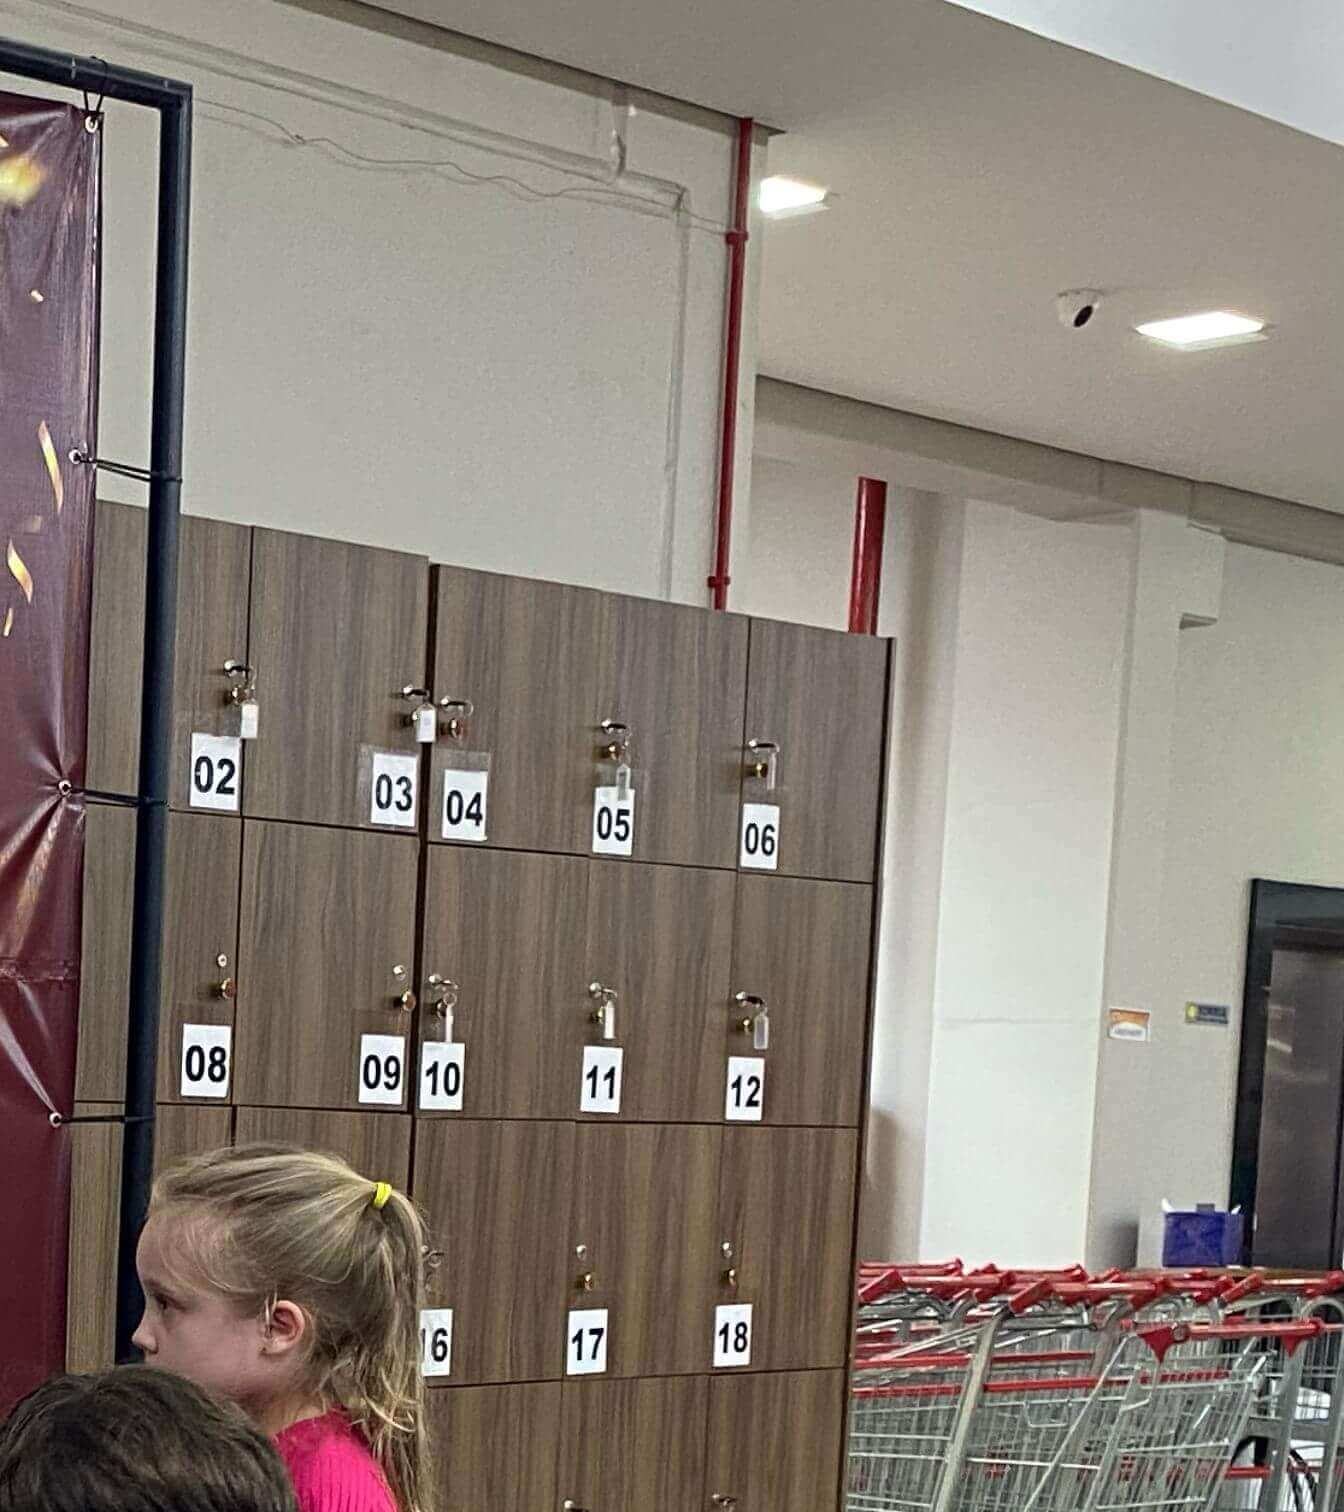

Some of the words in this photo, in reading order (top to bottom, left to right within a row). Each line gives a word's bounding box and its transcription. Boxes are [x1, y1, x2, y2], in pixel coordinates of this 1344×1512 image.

[193, 755, 236, 795] 02
[374, 774, 413, 813] 03
[445, 790, 484, 828] 04
[596, 807, 630, 842] 05
[744, 822, 776, 857] 06
[185, 1044, 227, 1084] 08
[362, 1054, 402, 1092] 09
[425, 1060, 462, 1097] 10
[586, 1065, 618, 1100] 11
[729, 1075, 761, 1108] 12
[570, 1328, 605, 1361] 17
[717, 1321, 749, 1354] 18
